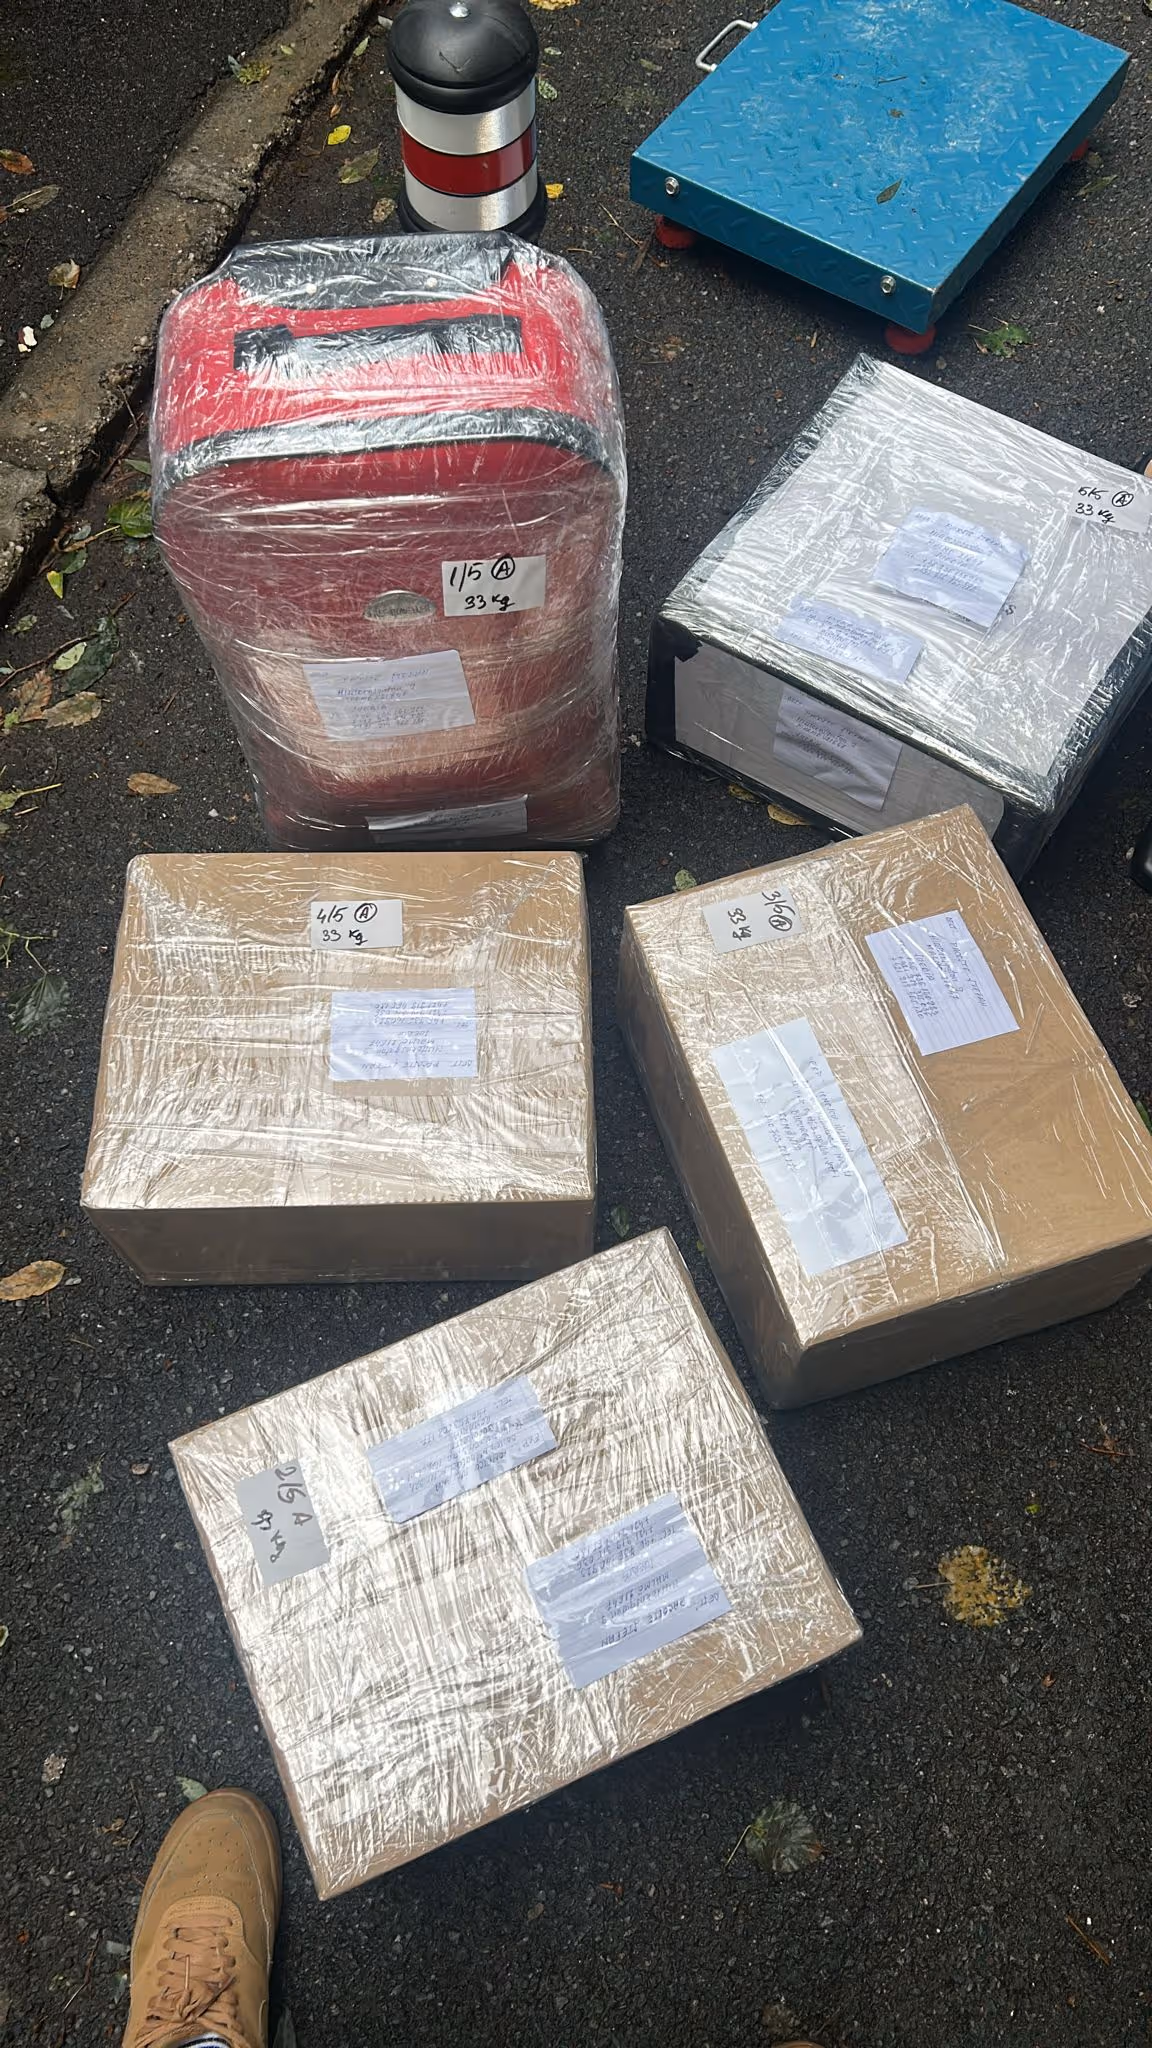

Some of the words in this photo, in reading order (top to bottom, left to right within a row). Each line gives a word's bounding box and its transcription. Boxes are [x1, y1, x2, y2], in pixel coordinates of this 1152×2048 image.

[1077, 486, 1109, 501] 5/5
[1075, 503, 1094, 516] 33
[450, 562, 483, 592] 1/5
[464, 594, 487, 610] 33
[761, 890, 796, 915] 3/5
[316, 905, 349, 924] 4/5
[727, 907, 747, 925] 33
[322, 929, 342, 942] 33
[292, 1512, 313, 1526] A
